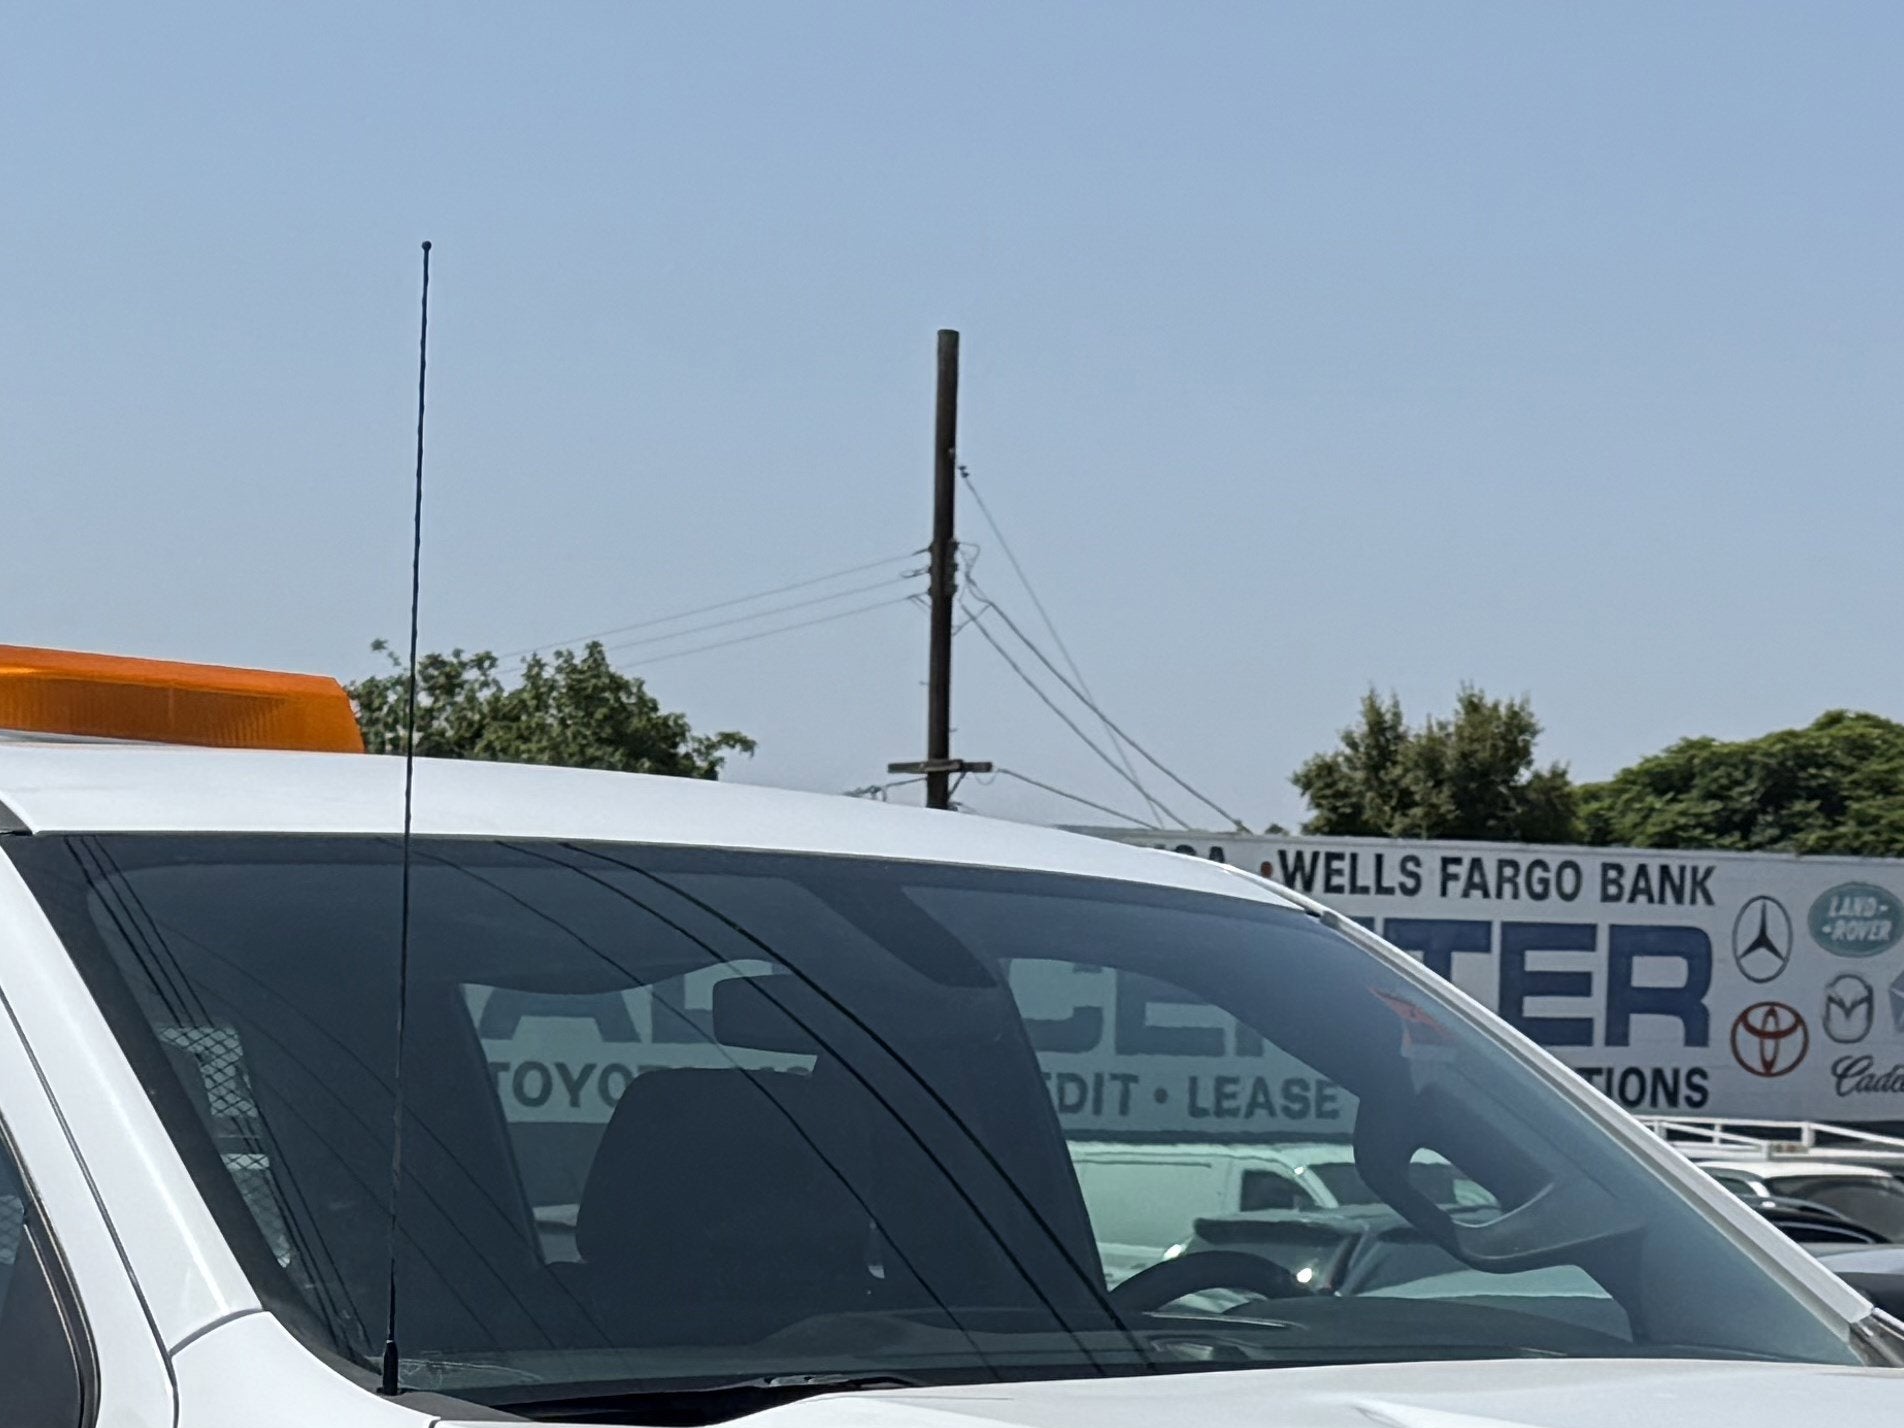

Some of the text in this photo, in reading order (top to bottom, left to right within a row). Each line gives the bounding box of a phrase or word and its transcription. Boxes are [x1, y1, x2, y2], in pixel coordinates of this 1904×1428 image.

[1278, 849, 1423, 897] WELLS
[1439, 857, 1582, 902] FARGO
[1600, 861, 1716, 906] BANK
[1041, 1071, 1342, 1120] DIT LEASE
